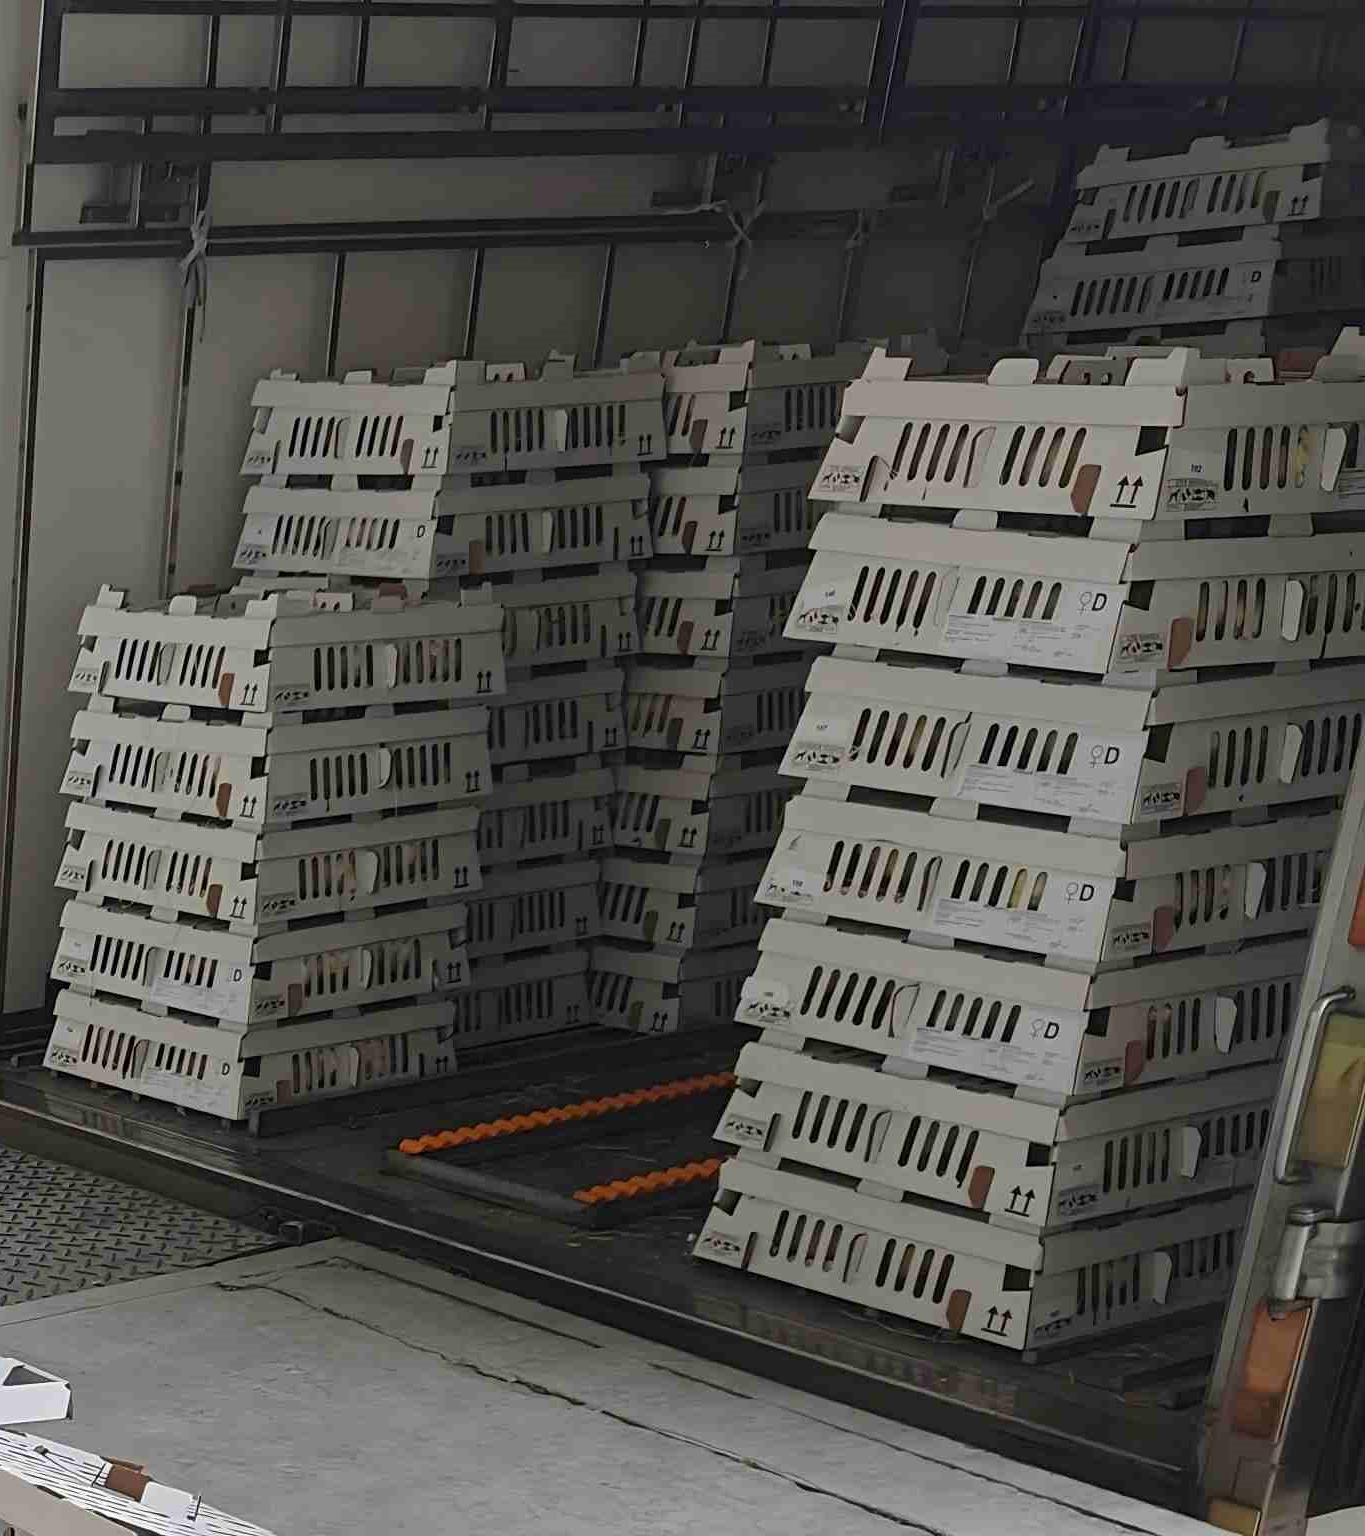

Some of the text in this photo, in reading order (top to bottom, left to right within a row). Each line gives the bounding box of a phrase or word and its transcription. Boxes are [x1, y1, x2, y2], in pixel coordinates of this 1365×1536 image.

[1091, 592, 1108, 612] D
[1104, 746, 1120, 765] D
[1078, 884, 1094, 902] D
[1043, 1021, 1060, 1040] D
